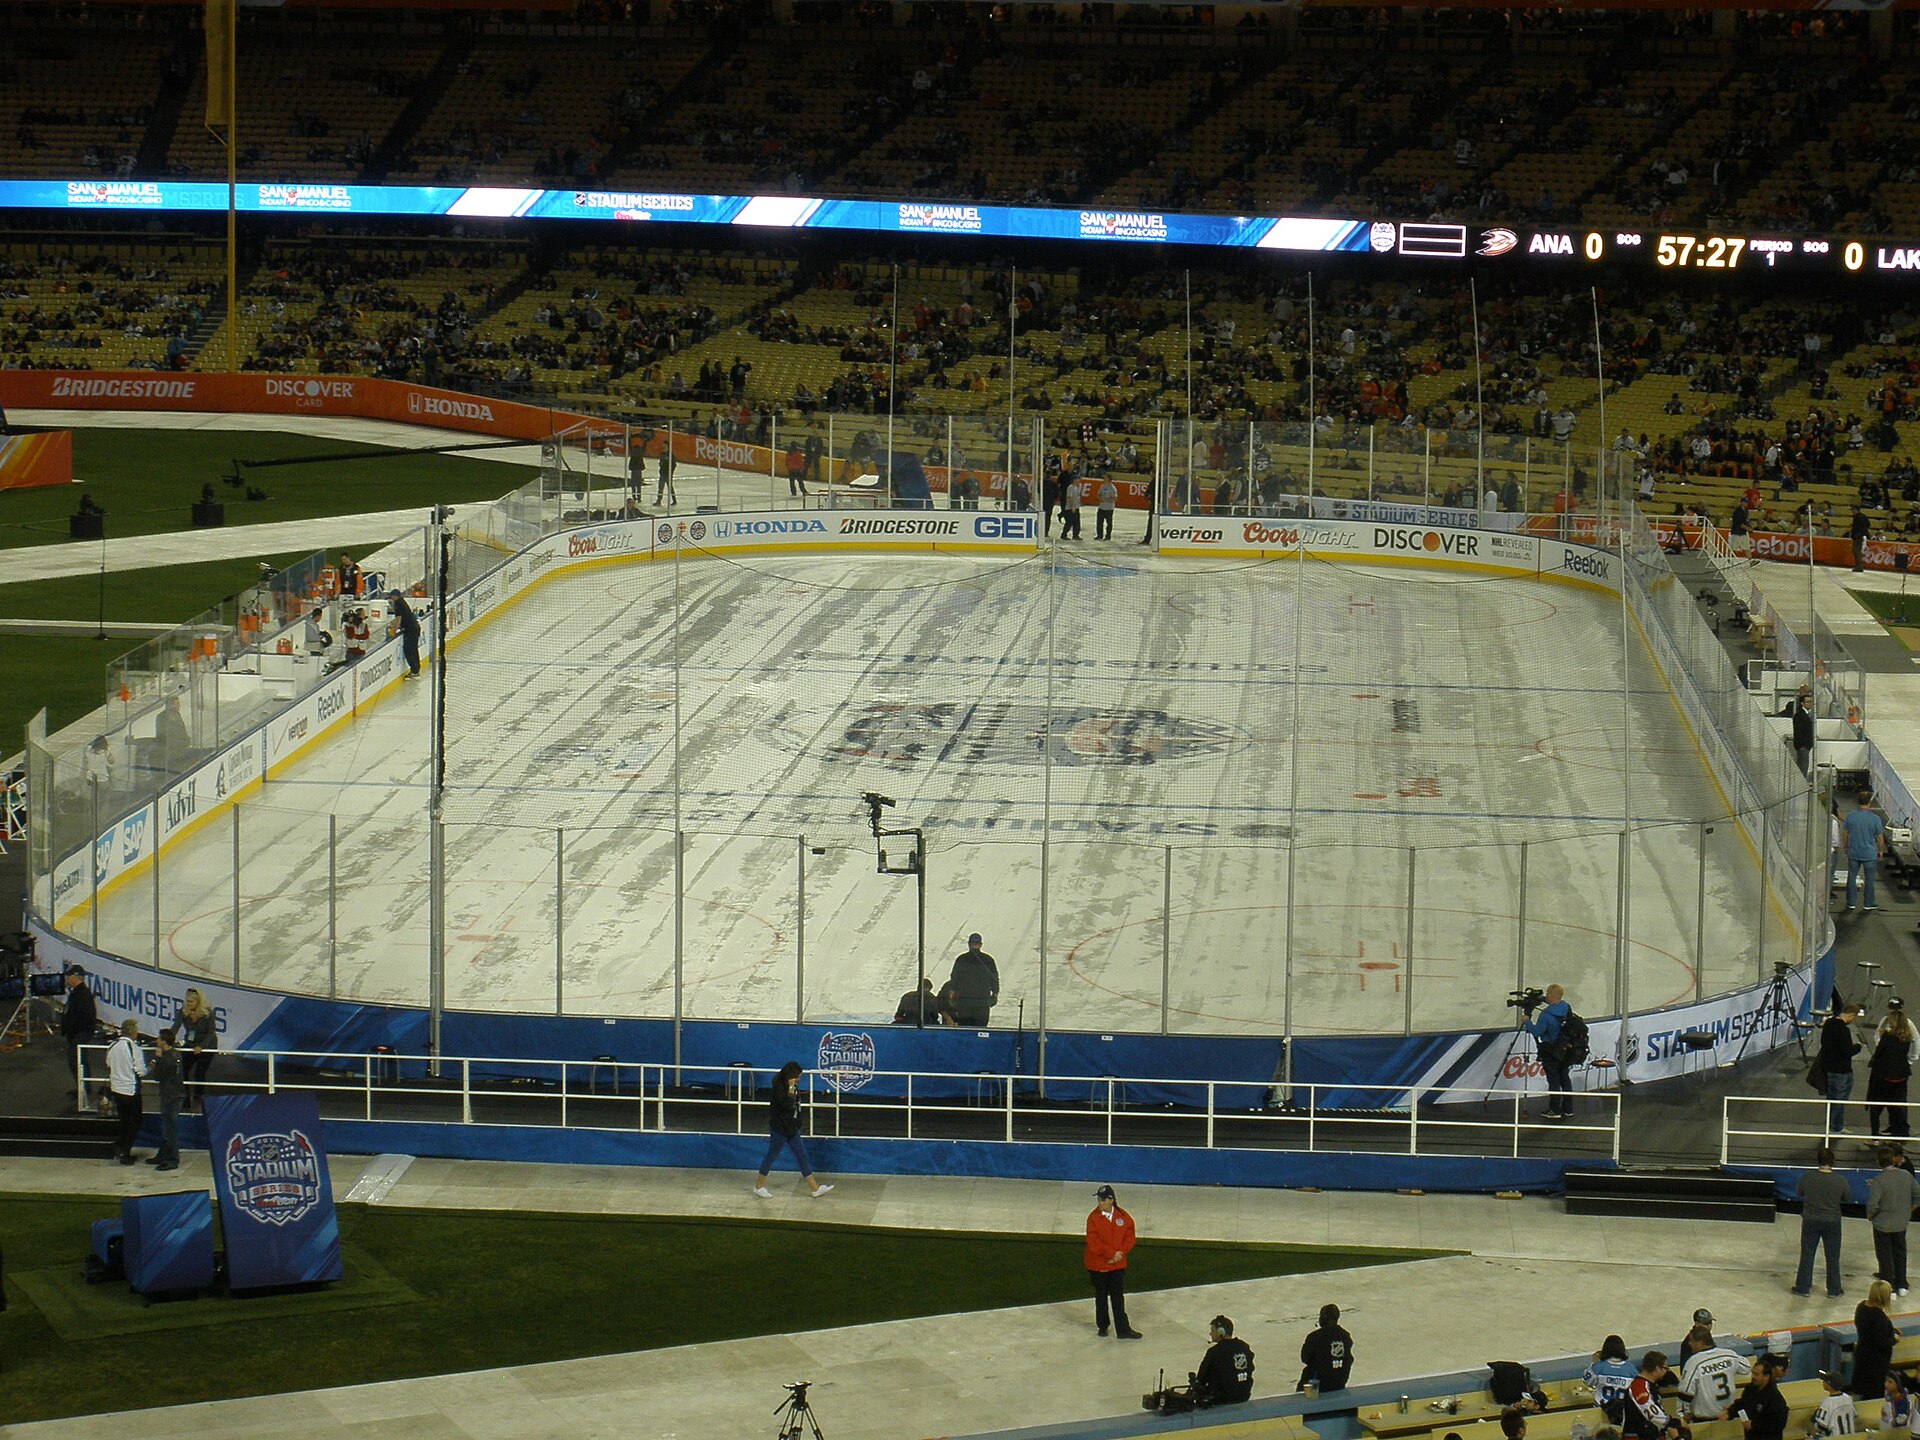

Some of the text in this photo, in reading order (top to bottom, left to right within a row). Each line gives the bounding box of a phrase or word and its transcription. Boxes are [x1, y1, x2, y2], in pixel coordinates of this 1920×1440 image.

[67, 182, 161, 196] SAN MANUEL
[259, 185, 350, 200] SAN MANUEL
[259, 198, 286, 206] INDIAN
[588, 193, 693, 211] STADIUM SERIES
[899, 204, 981, 221] SAN MANUEL
[900, 218, 923, 226] INDIAN
[1080, 211, 1106, 226] SAN
[1115, 213, 1167, 229] MANUEL
[1080, 226, 1106, 235] INDIAN
[1529, 233, 1573, 255] ANA
[1585, 232, 1603, 260] 0
[1616, 233, 1642, 246] SOG
[1750, 240, 1793, 253] PERIOD
[1803, 240, 1829, 253] SOG
[1656, 235, 1746, 268] 57:27
[1766, 251, 1775, 267] 1
[1844, 242, 1864, 270] 0
[51, 377, 195, 398] BRIDGESTONE
[265, 379, 354, 398] DISCOVER
[296, 398, 322, 408] CARD
[424, 397, 494, 422] HONDA
[695, 437, 755, 466] Reebok
[1352, 503, 1479, 528] STADIUM SERIES
[734, 519, 828, 535] HONDA
[838, 517, 960, 536] BRIDGESTONE
[1160, 525, 1224, 543] verizon
[1243, 521, 1356, 547] Coors LIGHT
[568, 532, 633, 558] Coors LIGHT
[1373, 527, 1479, 557] DISCOVER
[1746, 535, 1811, 558] eebok
[1564, 548, 1609, 580] Reebok
[317, 682, 347, 724] Reebok
[287, 716, 309, 742] verizon
[164, 778, 197, 835] Advil
[123, 820, 144, 857] SAP
[85, 971, 227, 1034] TADIUM SERS
[821, 1051, 872, 1067] STADIUM
[1503, 1055, 1547, 1080] Coo
[231, 1159, 316, 1188] STADIUM
[253, 1184, 300, 1196] SERIES
[1700, 1358, 1733, 1375] JOHNSON
[1711, 1372, 1731, 1401] 3
[1836, 1412, 1852, 1436] 11
